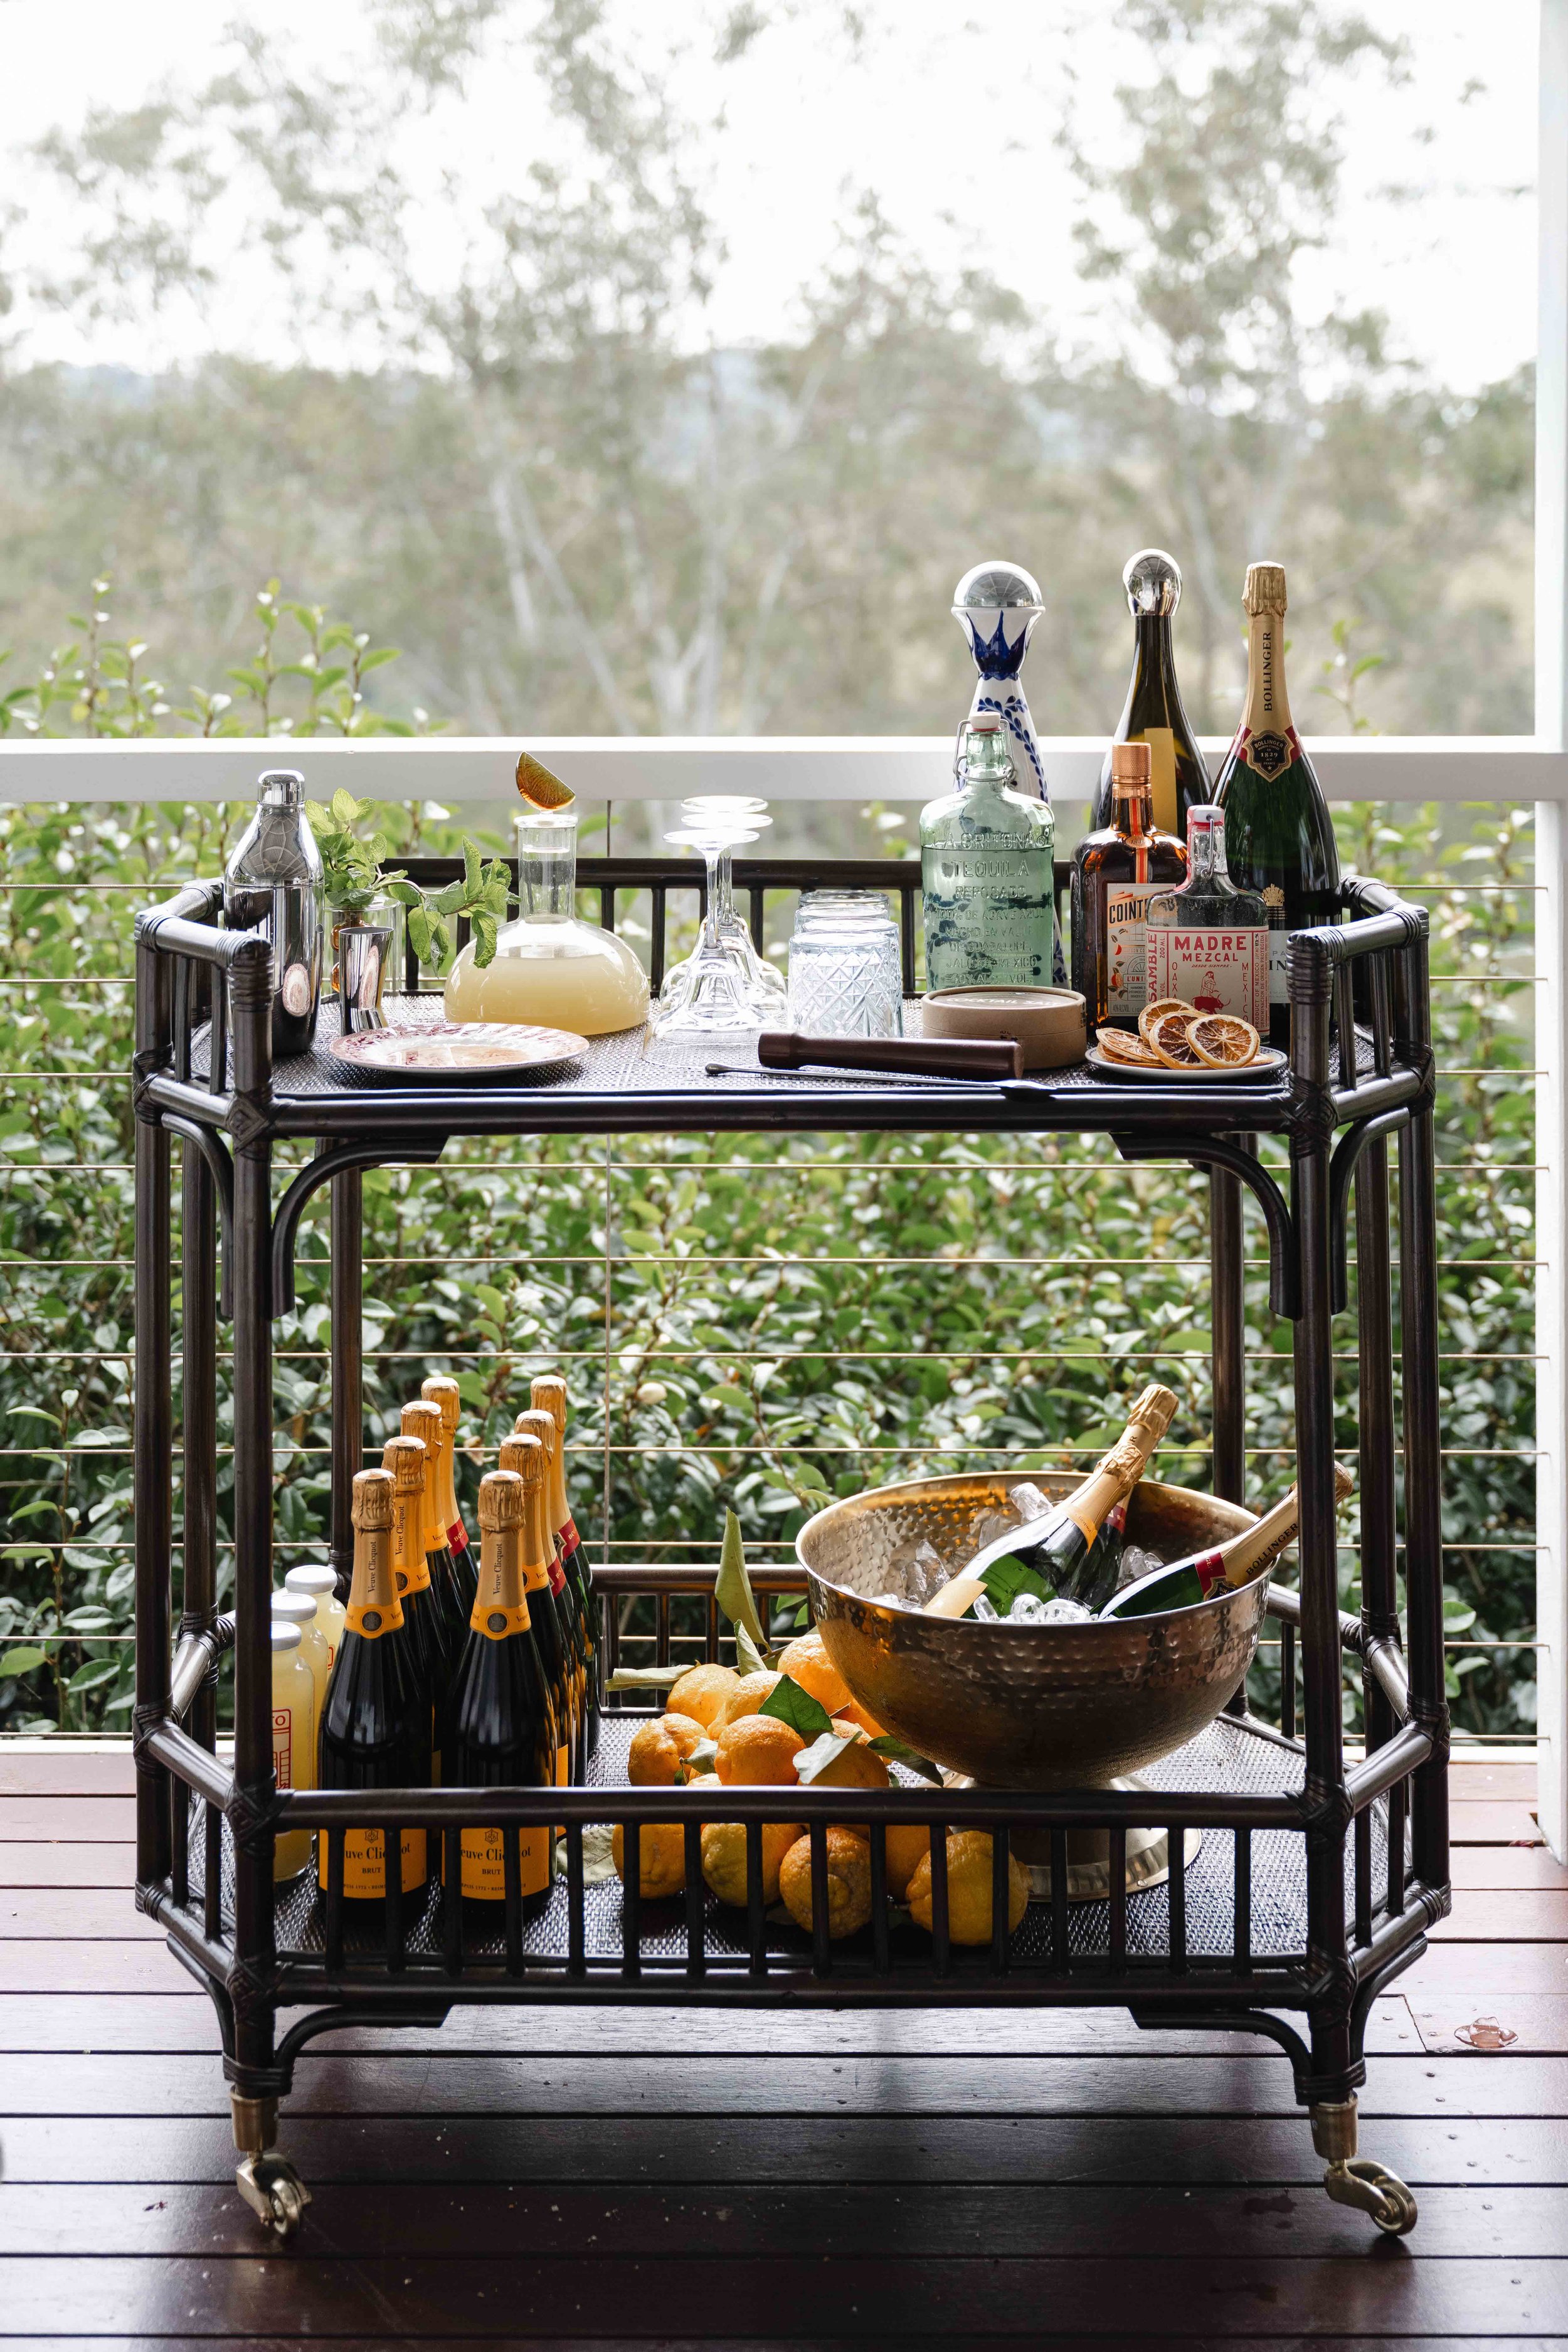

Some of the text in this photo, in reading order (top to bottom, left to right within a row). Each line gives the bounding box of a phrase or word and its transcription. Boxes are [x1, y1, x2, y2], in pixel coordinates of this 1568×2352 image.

[1263, 632, 1273, 711] BOLLINGER
[1254, 739, 1284, 748] BOLLINGER
[950, 859, 1029, 877] TEQUILA
[955, 885, 1026, 899] REPOSADO
[983, 909, 1016, 920] AGAVE
[1019, 908, 1045, 919] AZUL
[1109, 898, 1147, 924] COINT
[984, 927, 998, 937] EN
[1174, 936, 1247, 951] MADRE
[1182, 953, 1239, 962] MEZCAL
[1148, 933, 1157, 1003] SAMBLE
[1255, 988, 1259, 997] OF
[395, 1506, 405, 1555] Veuve Clicquot
[1246, 1523, 1298, 1576] BOLLINGER
[368, 1541, 378, 1594] Veuve Clicquot
[493, 1543, 504, 1596] Veuve Clicquot
[345, 1850, 363, 1860] uve
[462, 1849, 483, 1860] euve
